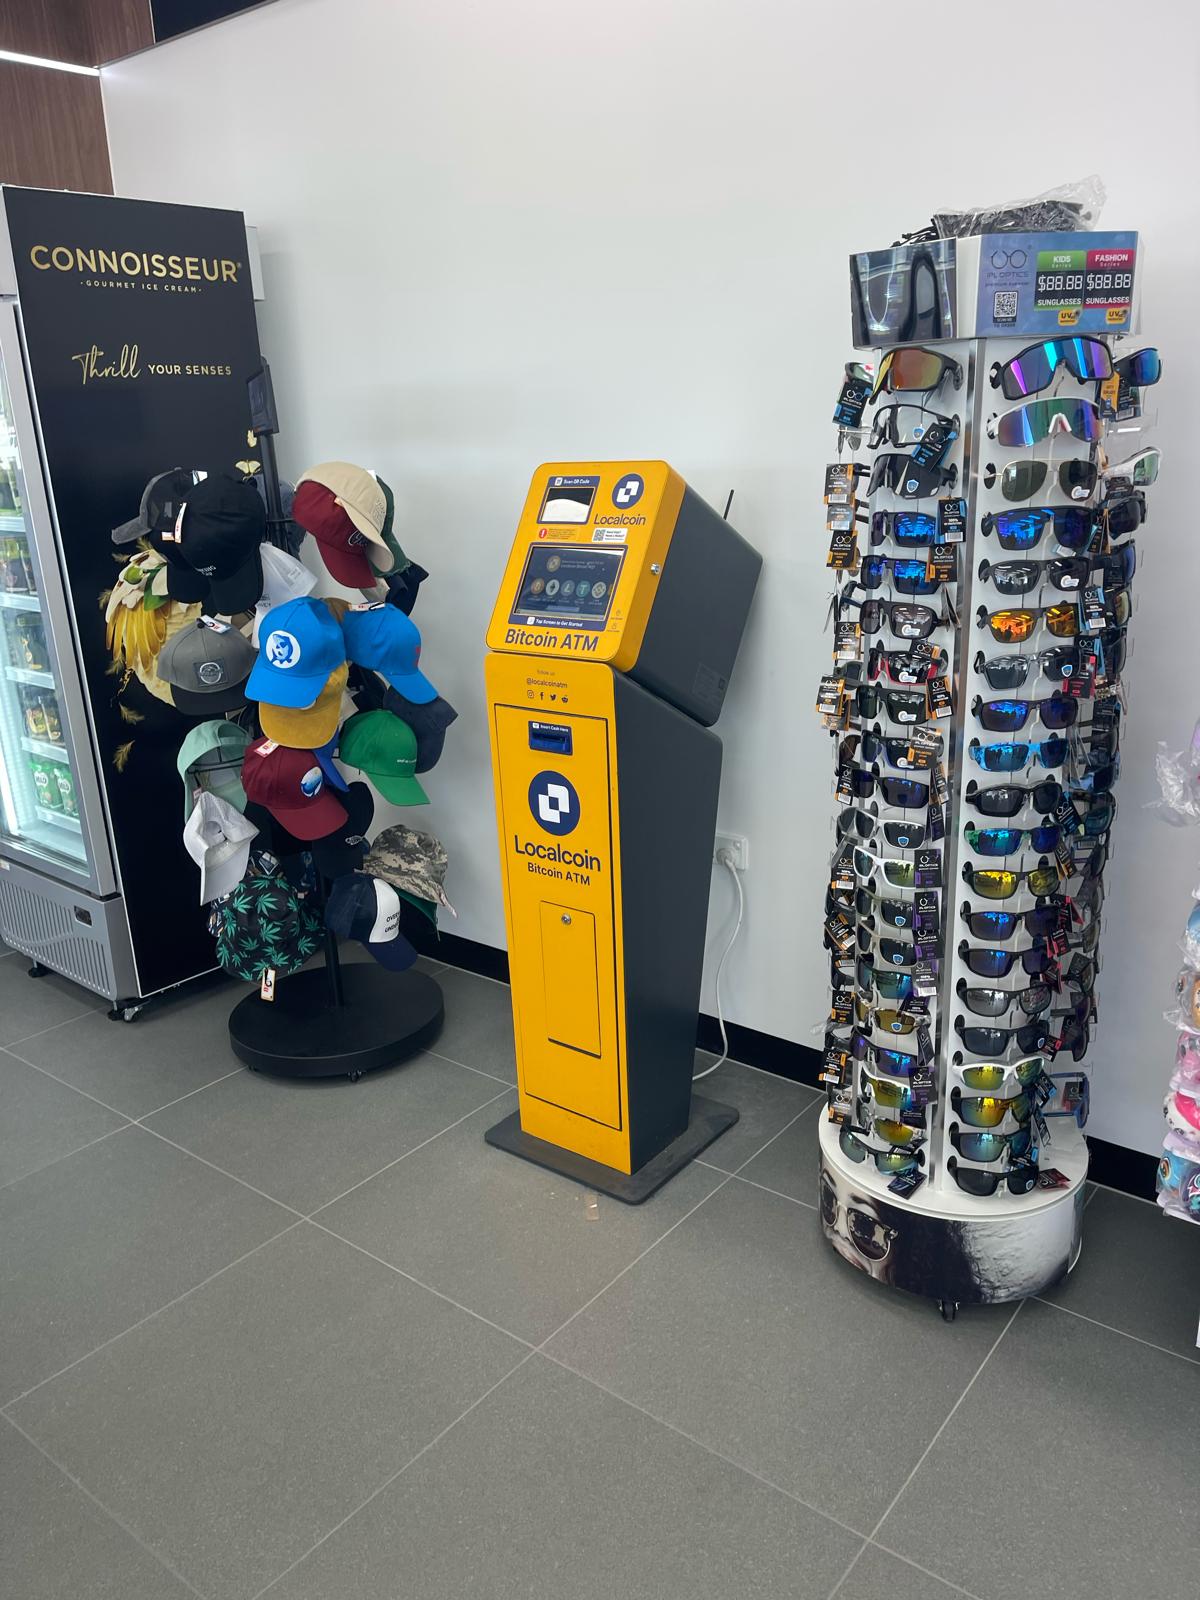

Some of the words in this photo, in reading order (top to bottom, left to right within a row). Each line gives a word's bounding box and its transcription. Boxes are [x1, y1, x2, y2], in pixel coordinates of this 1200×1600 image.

[30, 245, 239, 283] CONNOISSEUR
[1053, 255, 1071, 263] KIDS
[1095, 254, 1129, 262] FASHION
[86, 280, 136, 290] GOURMET
[141, 283, 158, 291] ICE
[164, 285, 197, 293] CREAM
[1038, 275, 1083, 292] $88.88
[1086, 273, 1132, 291] $88.88
[1038, 298, 1082, 306] SUNGLASSES
[1085, 296, 1130, 305] SUNGLASSES
[71, 344, 142, 385] Thrill
[148, 364, 182, 375] YOUR
[185, 365, 232, 376] SENSES
[594, 514, 646, 526] Localcoin
[505, 628, 558, 648] Bitcoin
[560, 633, 599, 651] ATM
[527, 678, 568, 689] @localcoinatm
[514, 834, 601, 872] Localcoin
[527, 862, 563, 880] Bitcoin
[565, 872, 591, 886] ATM
